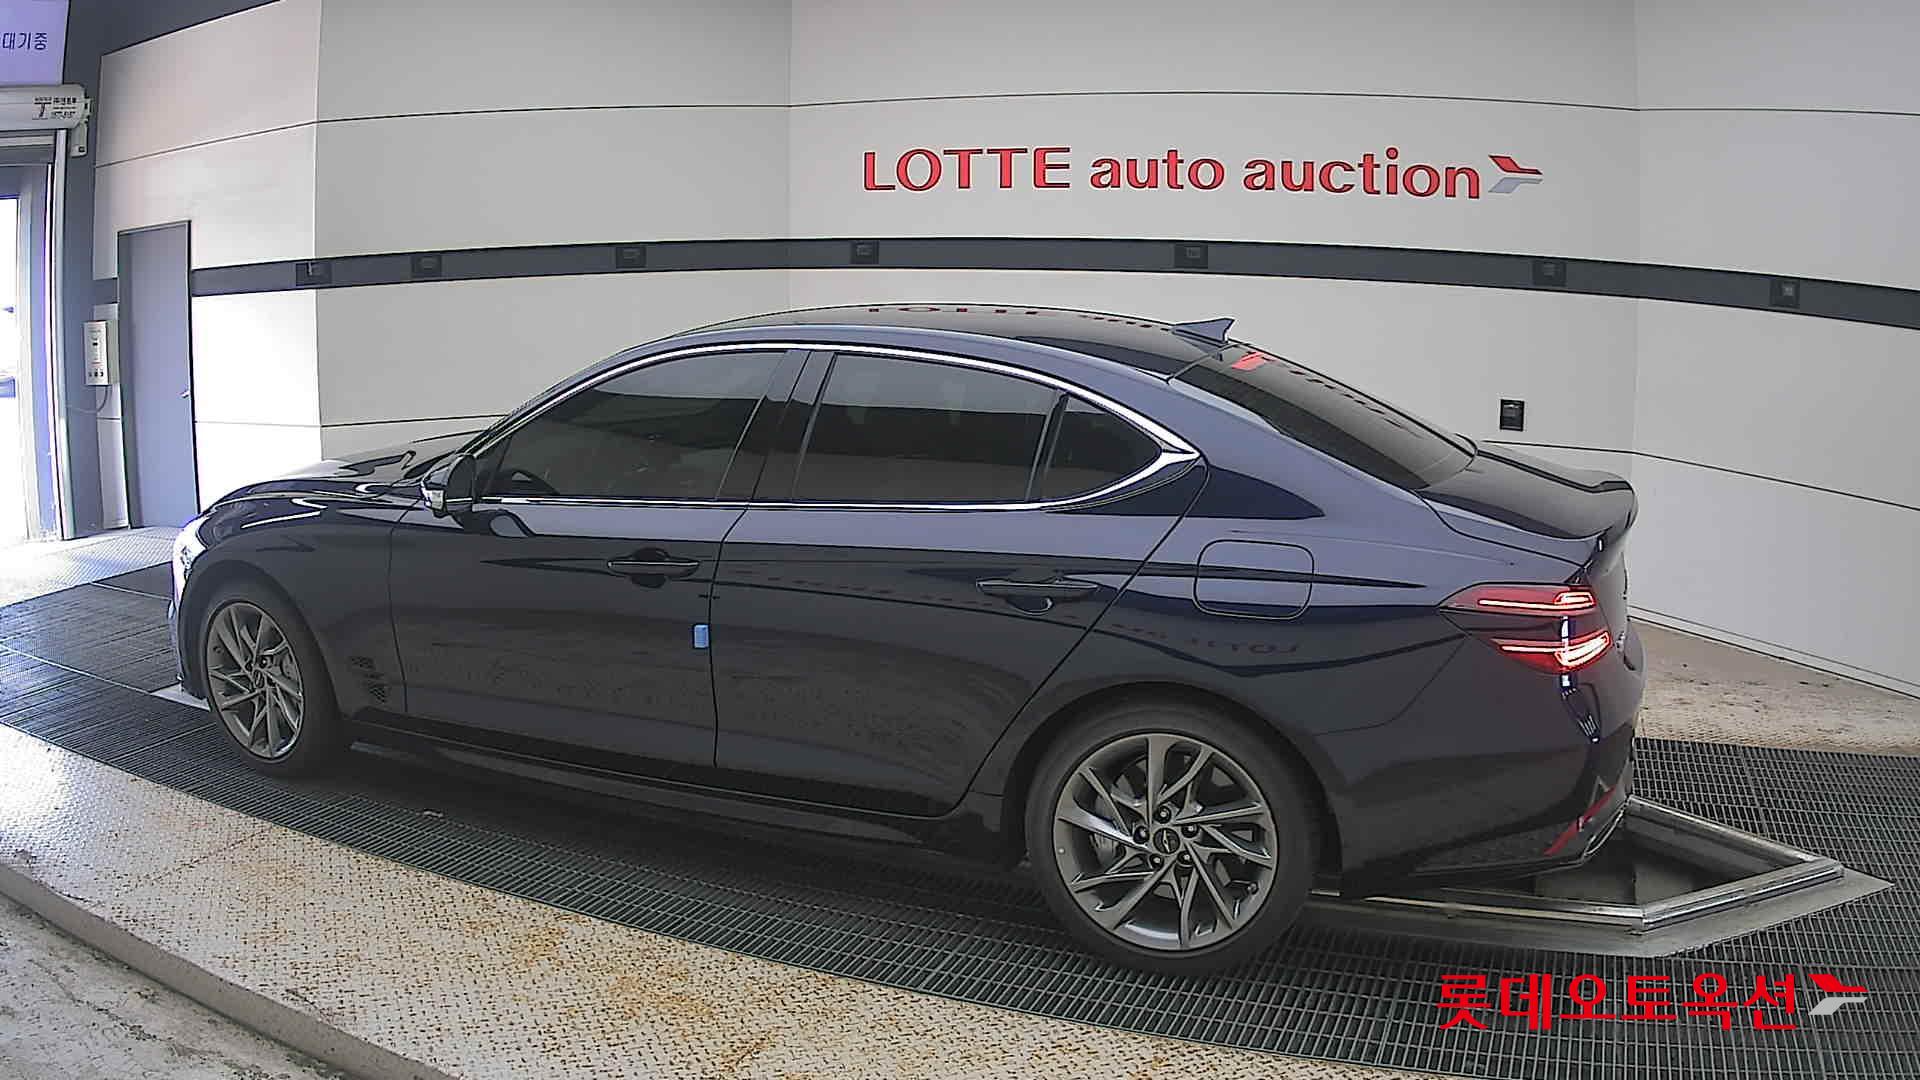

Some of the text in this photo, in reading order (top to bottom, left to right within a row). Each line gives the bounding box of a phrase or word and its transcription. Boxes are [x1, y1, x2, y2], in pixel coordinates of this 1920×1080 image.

[863, 146, 1482, 199] LOTTE auto auction
